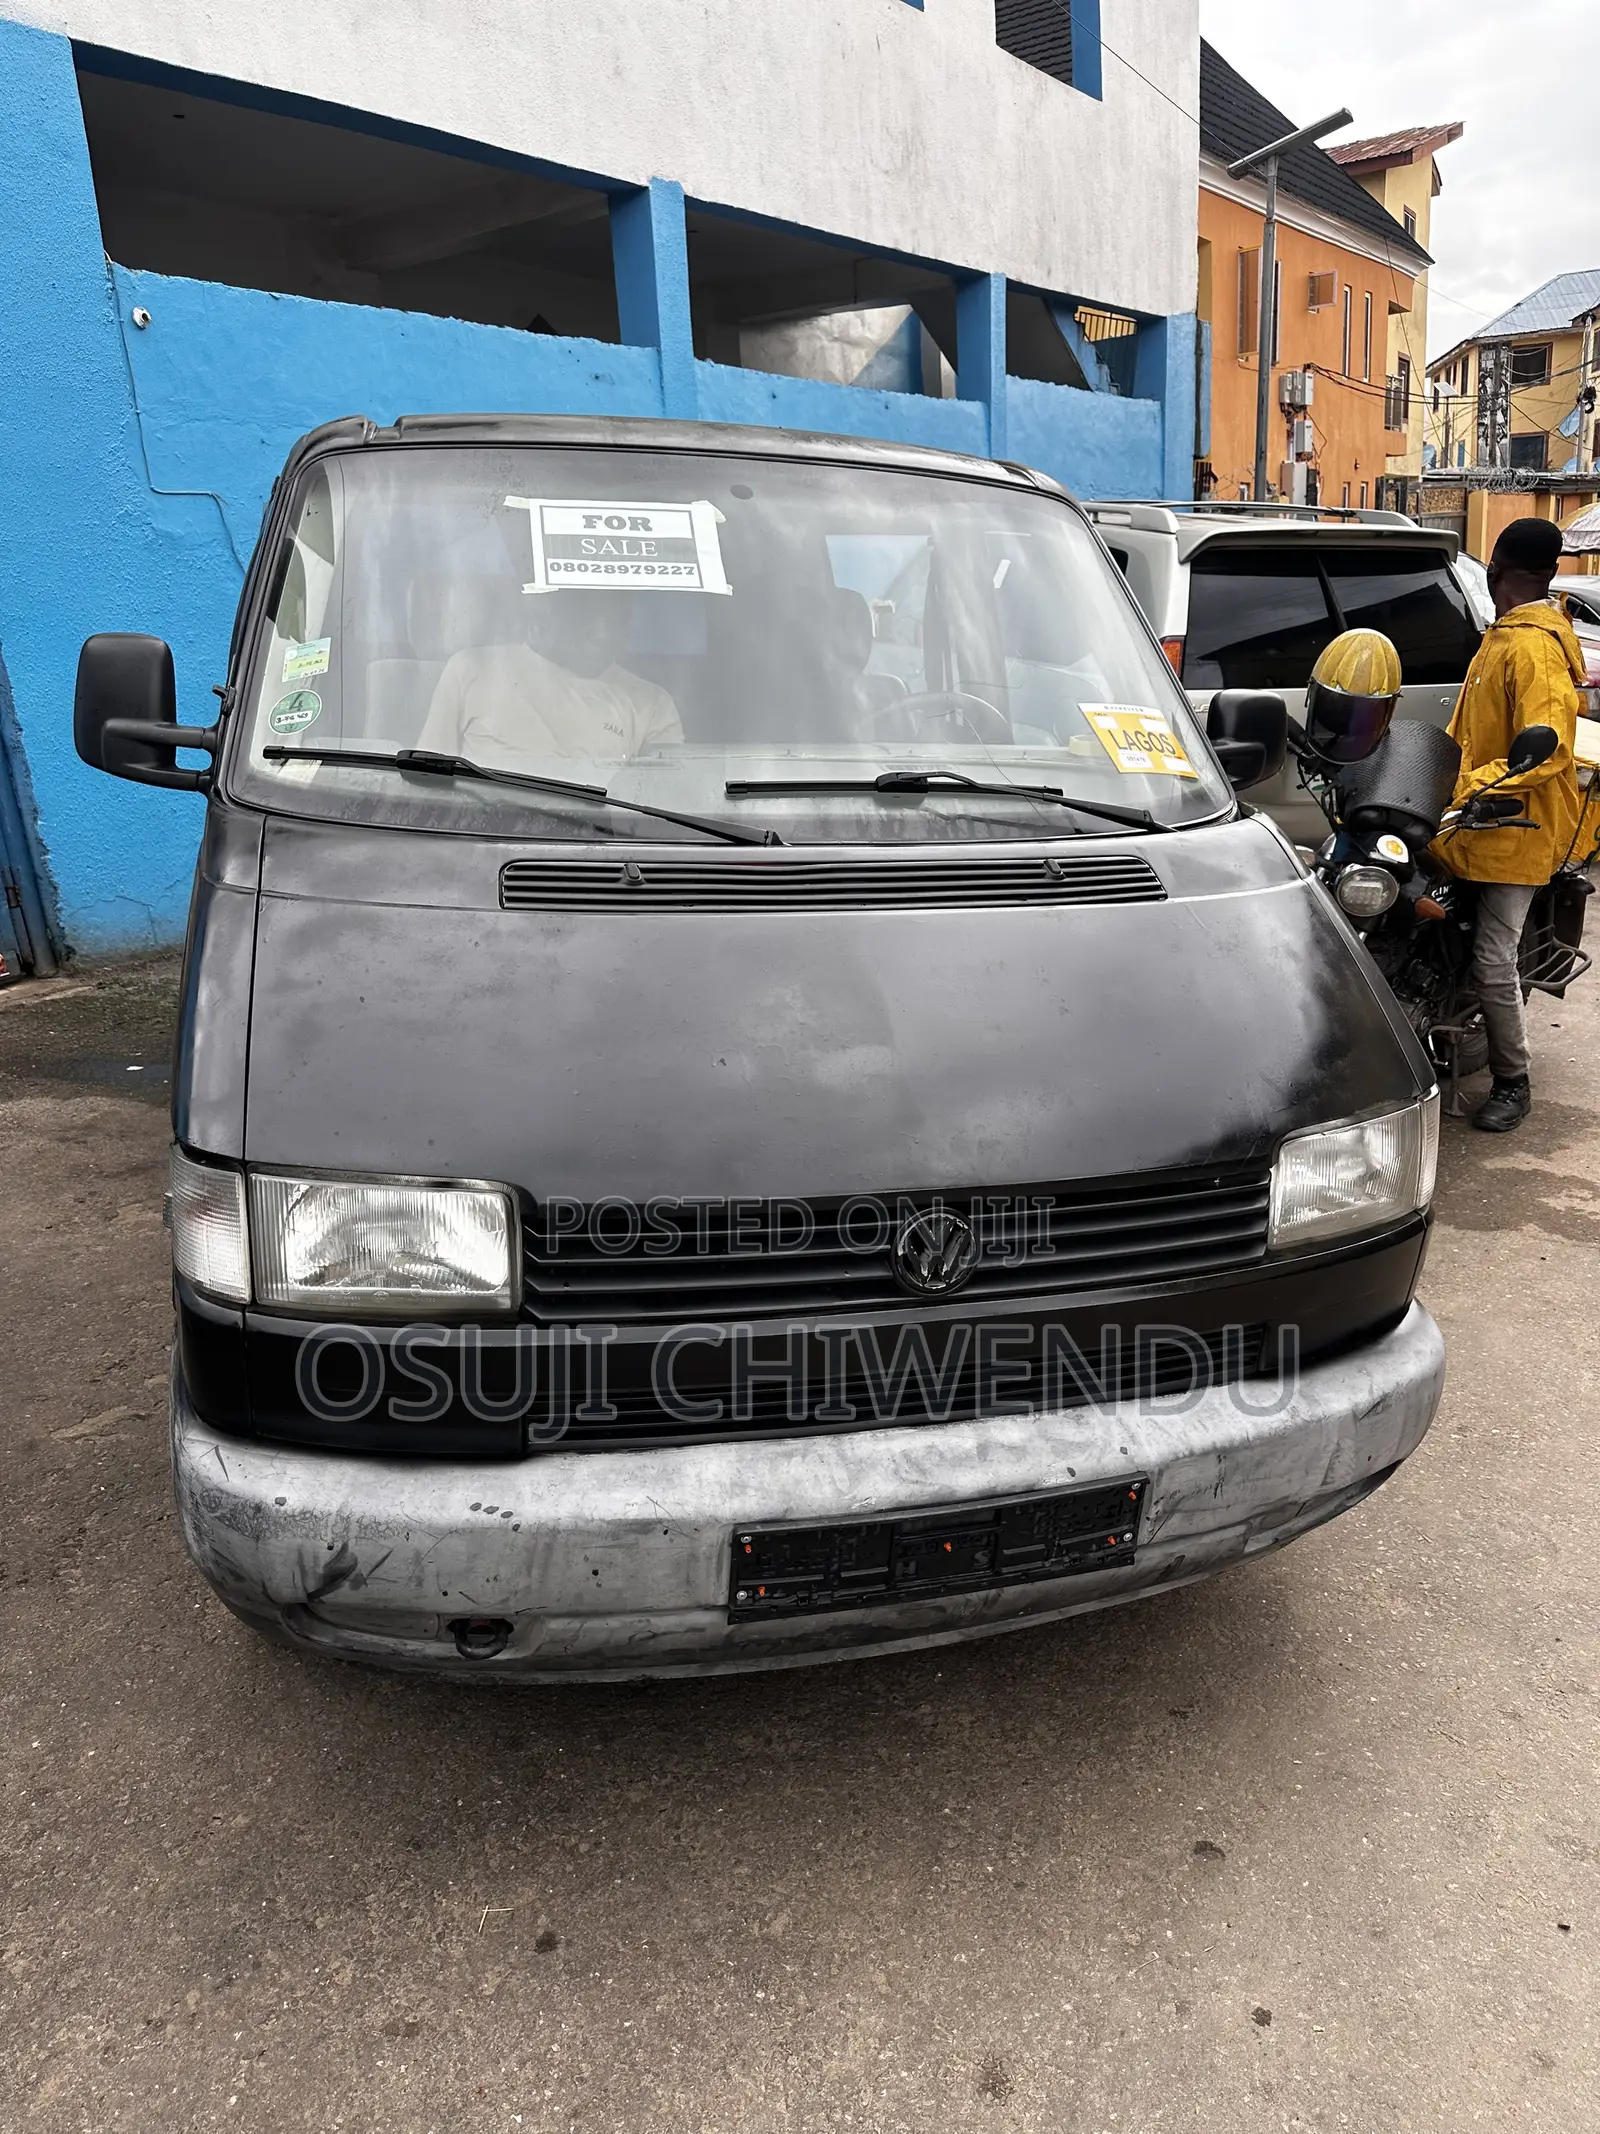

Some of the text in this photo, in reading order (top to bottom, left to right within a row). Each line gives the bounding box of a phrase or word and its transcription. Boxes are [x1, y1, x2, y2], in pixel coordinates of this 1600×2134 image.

[582, 515, 653, 532] FOR
[580, 538, 659, 557] SALE
[549, 562, 695, 576] 08028979227
[1108, 729, 1176, 755] LAGOS
